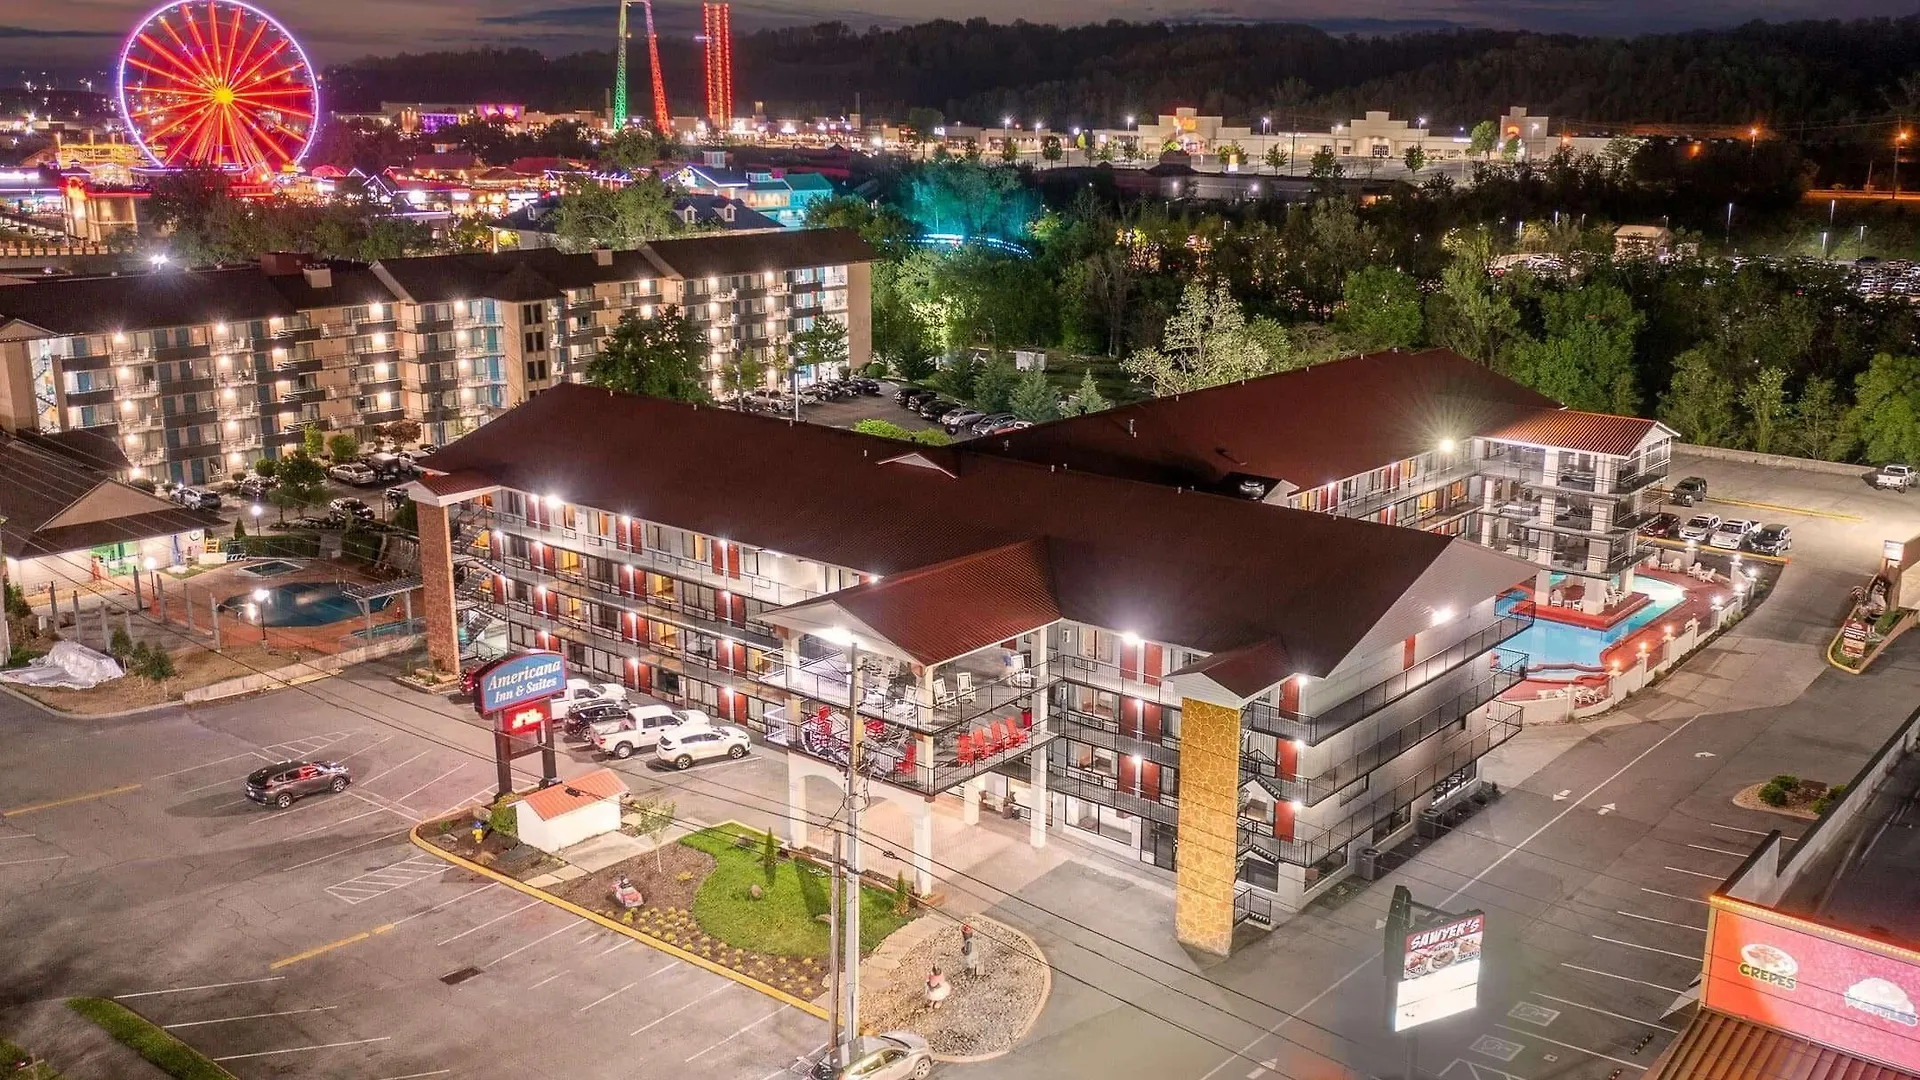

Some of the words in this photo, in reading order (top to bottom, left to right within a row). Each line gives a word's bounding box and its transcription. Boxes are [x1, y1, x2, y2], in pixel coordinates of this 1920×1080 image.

[488, 661, 560, 691] Americana
[494, 690, 513, 704] Inn
[515, 686, 524, 696] &
[526, 677, 557, 695] Suites
[1410, 919, 1480, 951] SAWYER'S
[1739, 962, 1796, 990] CREPES
